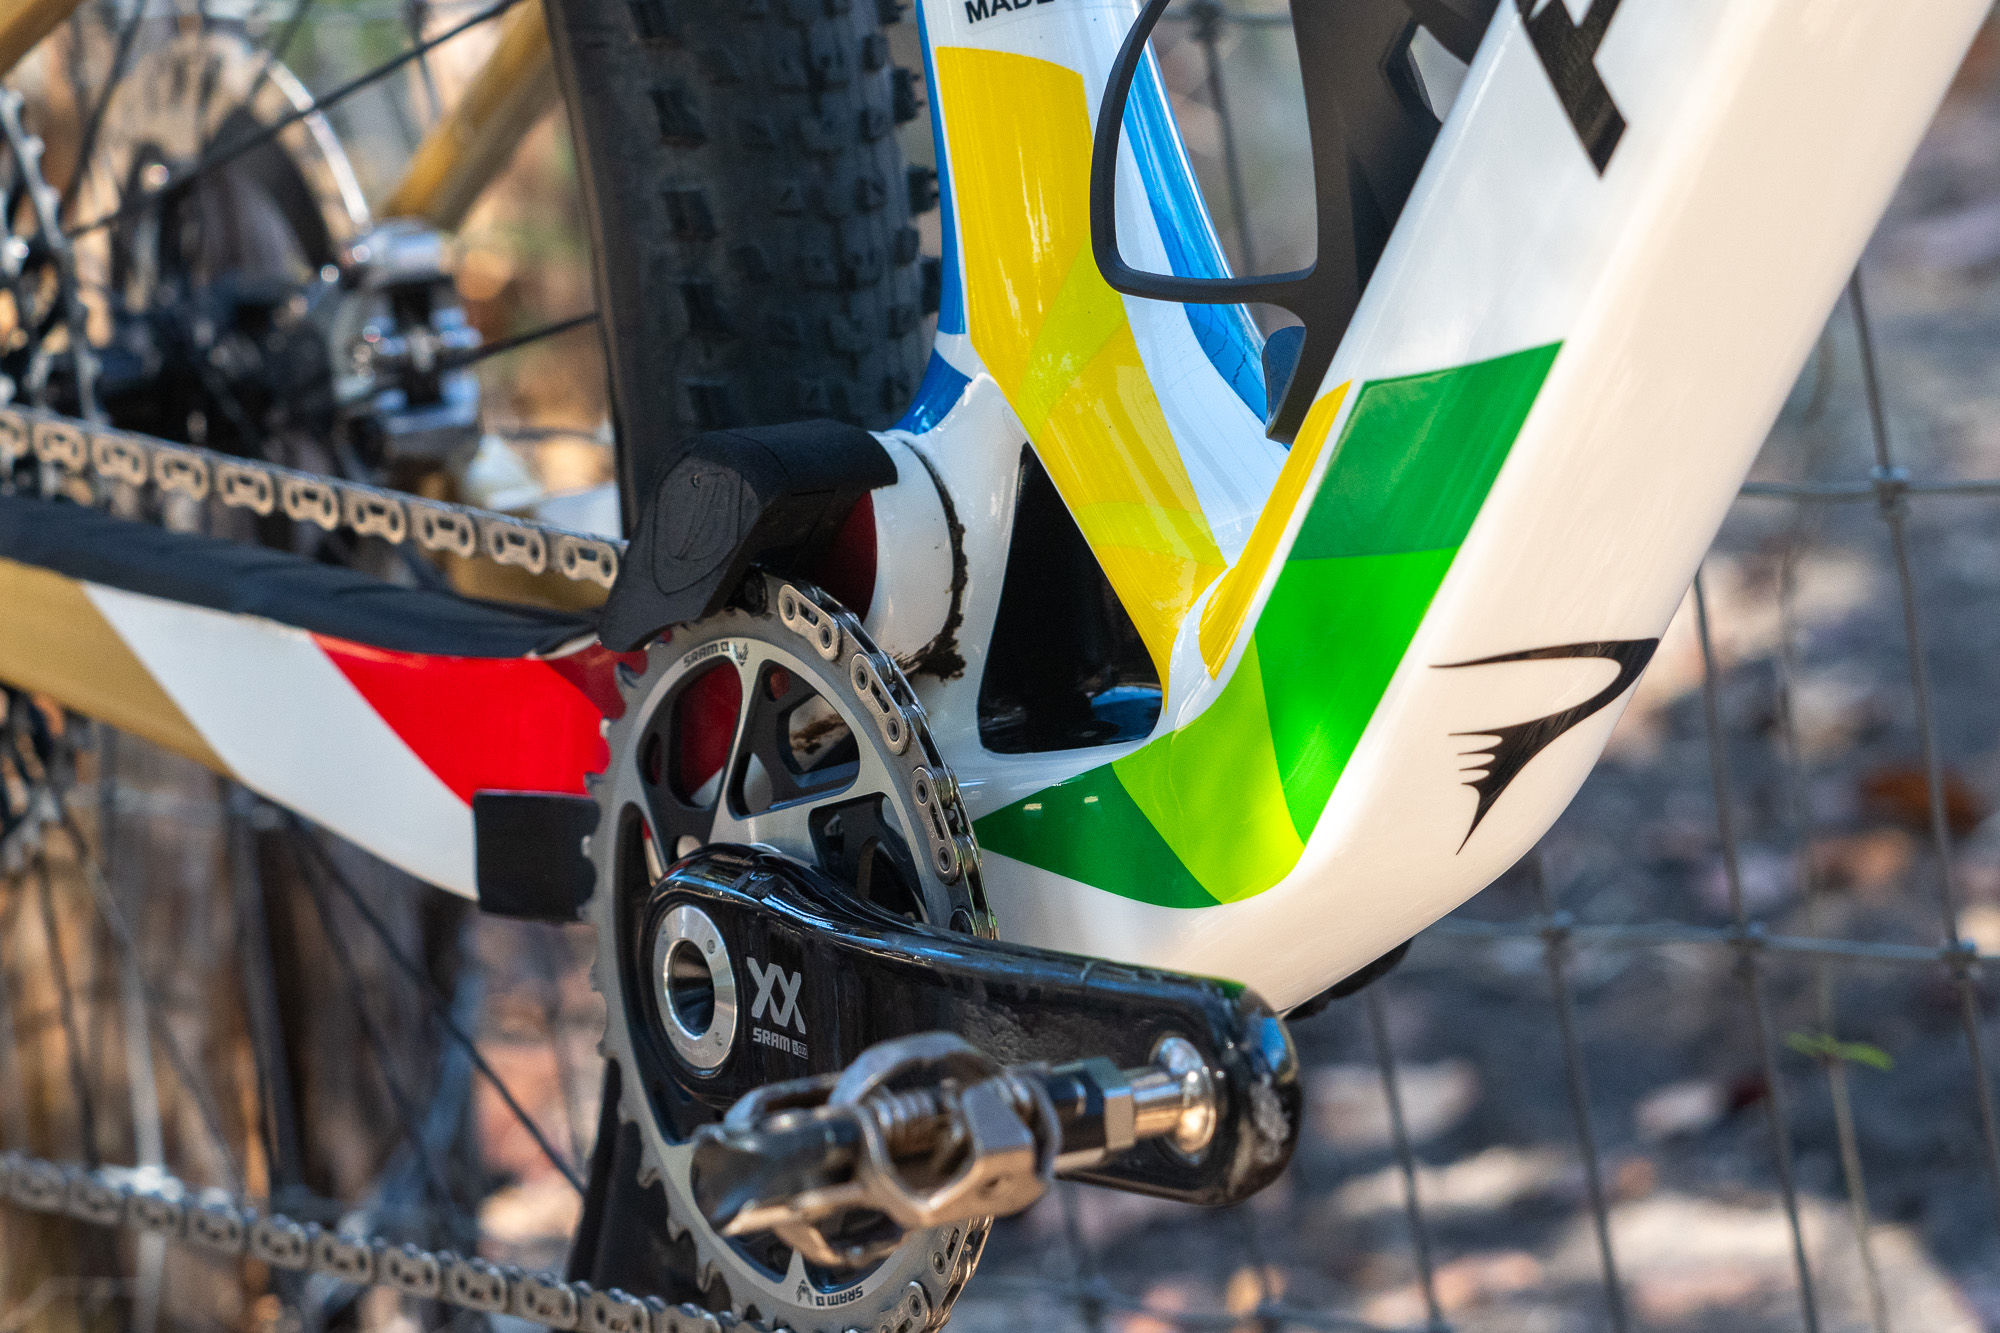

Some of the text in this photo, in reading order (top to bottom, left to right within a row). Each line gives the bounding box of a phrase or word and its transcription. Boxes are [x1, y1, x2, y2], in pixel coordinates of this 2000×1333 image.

[964, 0, 1055, 24] MA
[683, 642, 718, 668] SRAM
[746, 956, 806, 1035] XX
[752, 1026, 791, 1053] SRAM
[826, 1285, 864, 1307] SRAM
